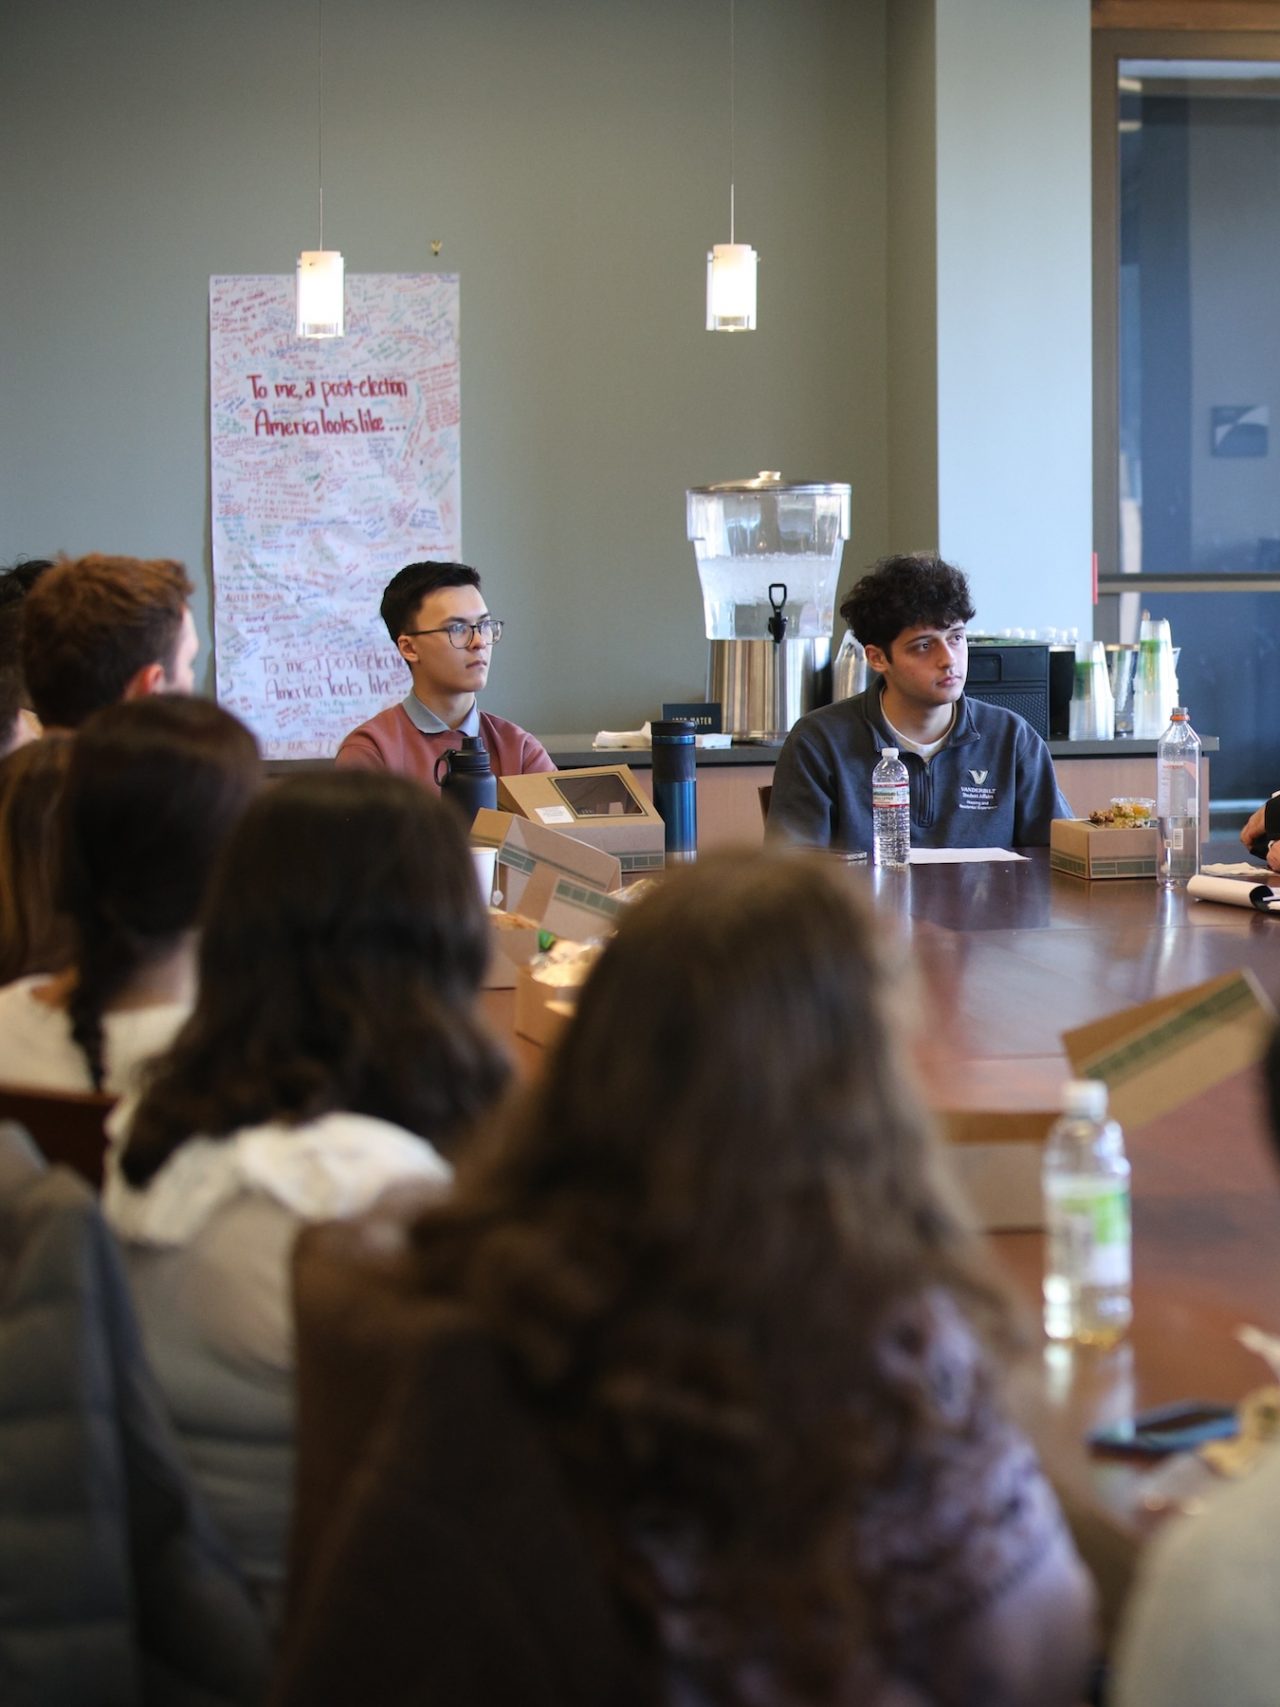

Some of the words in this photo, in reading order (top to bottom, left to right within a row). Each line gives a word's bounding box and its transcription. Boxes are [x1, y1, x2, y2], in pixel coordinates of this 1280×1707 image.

[246, 374, 268, 400] To
[274, 383, 303, 401] me,
[305, 380, 316, 399] a
[320, 375, 408, 408] post-election
[254, 408, 320, 437] America
[320, 407, 359, 434] looks
[259, 656, 279, 675] To
[265, 678, 324, 702] America
[326, 675, 363, 697] looks
[960, 786, 997, 794] VANDERBILT
